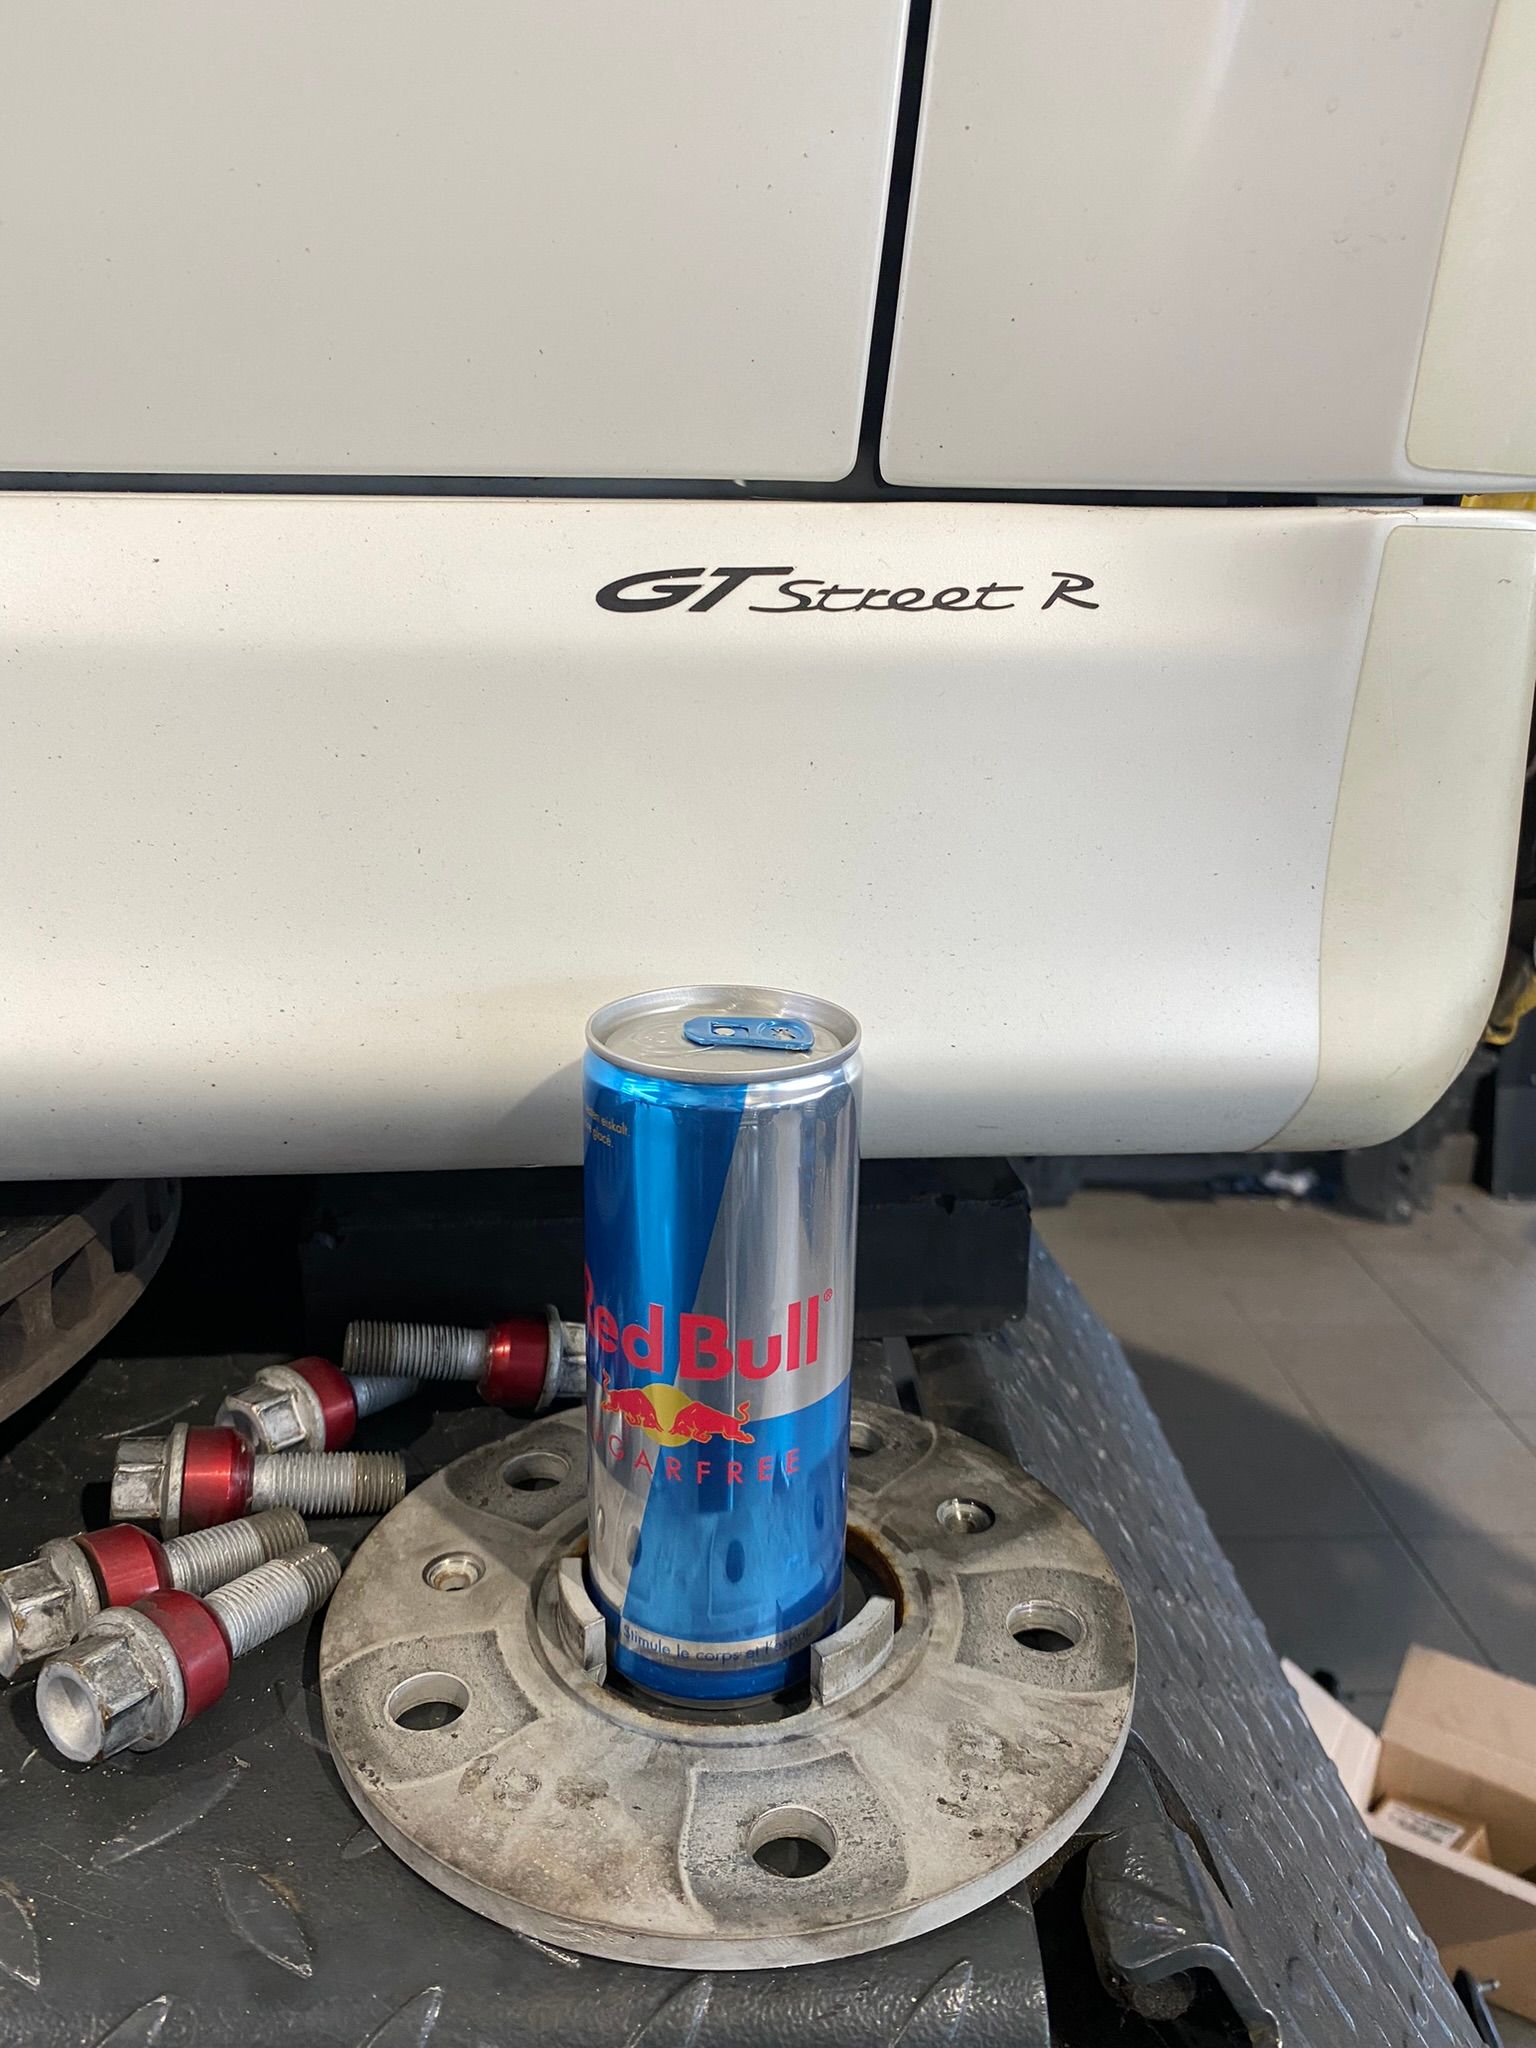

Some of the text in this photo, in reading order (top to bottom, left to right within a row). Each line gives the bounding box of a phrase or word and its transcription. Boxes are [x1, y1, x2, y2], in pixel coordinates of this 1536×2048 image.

[595, 566, 1099, 613] GT Street R
[592, 1415, 801, 1485] GARFREE
[623, 1624, 671, 1656] Stimule
[677, 1643, 690, 1659] le
[696, 1650, 740, 1666] corps
[746, 1645, 759, 1660] et
